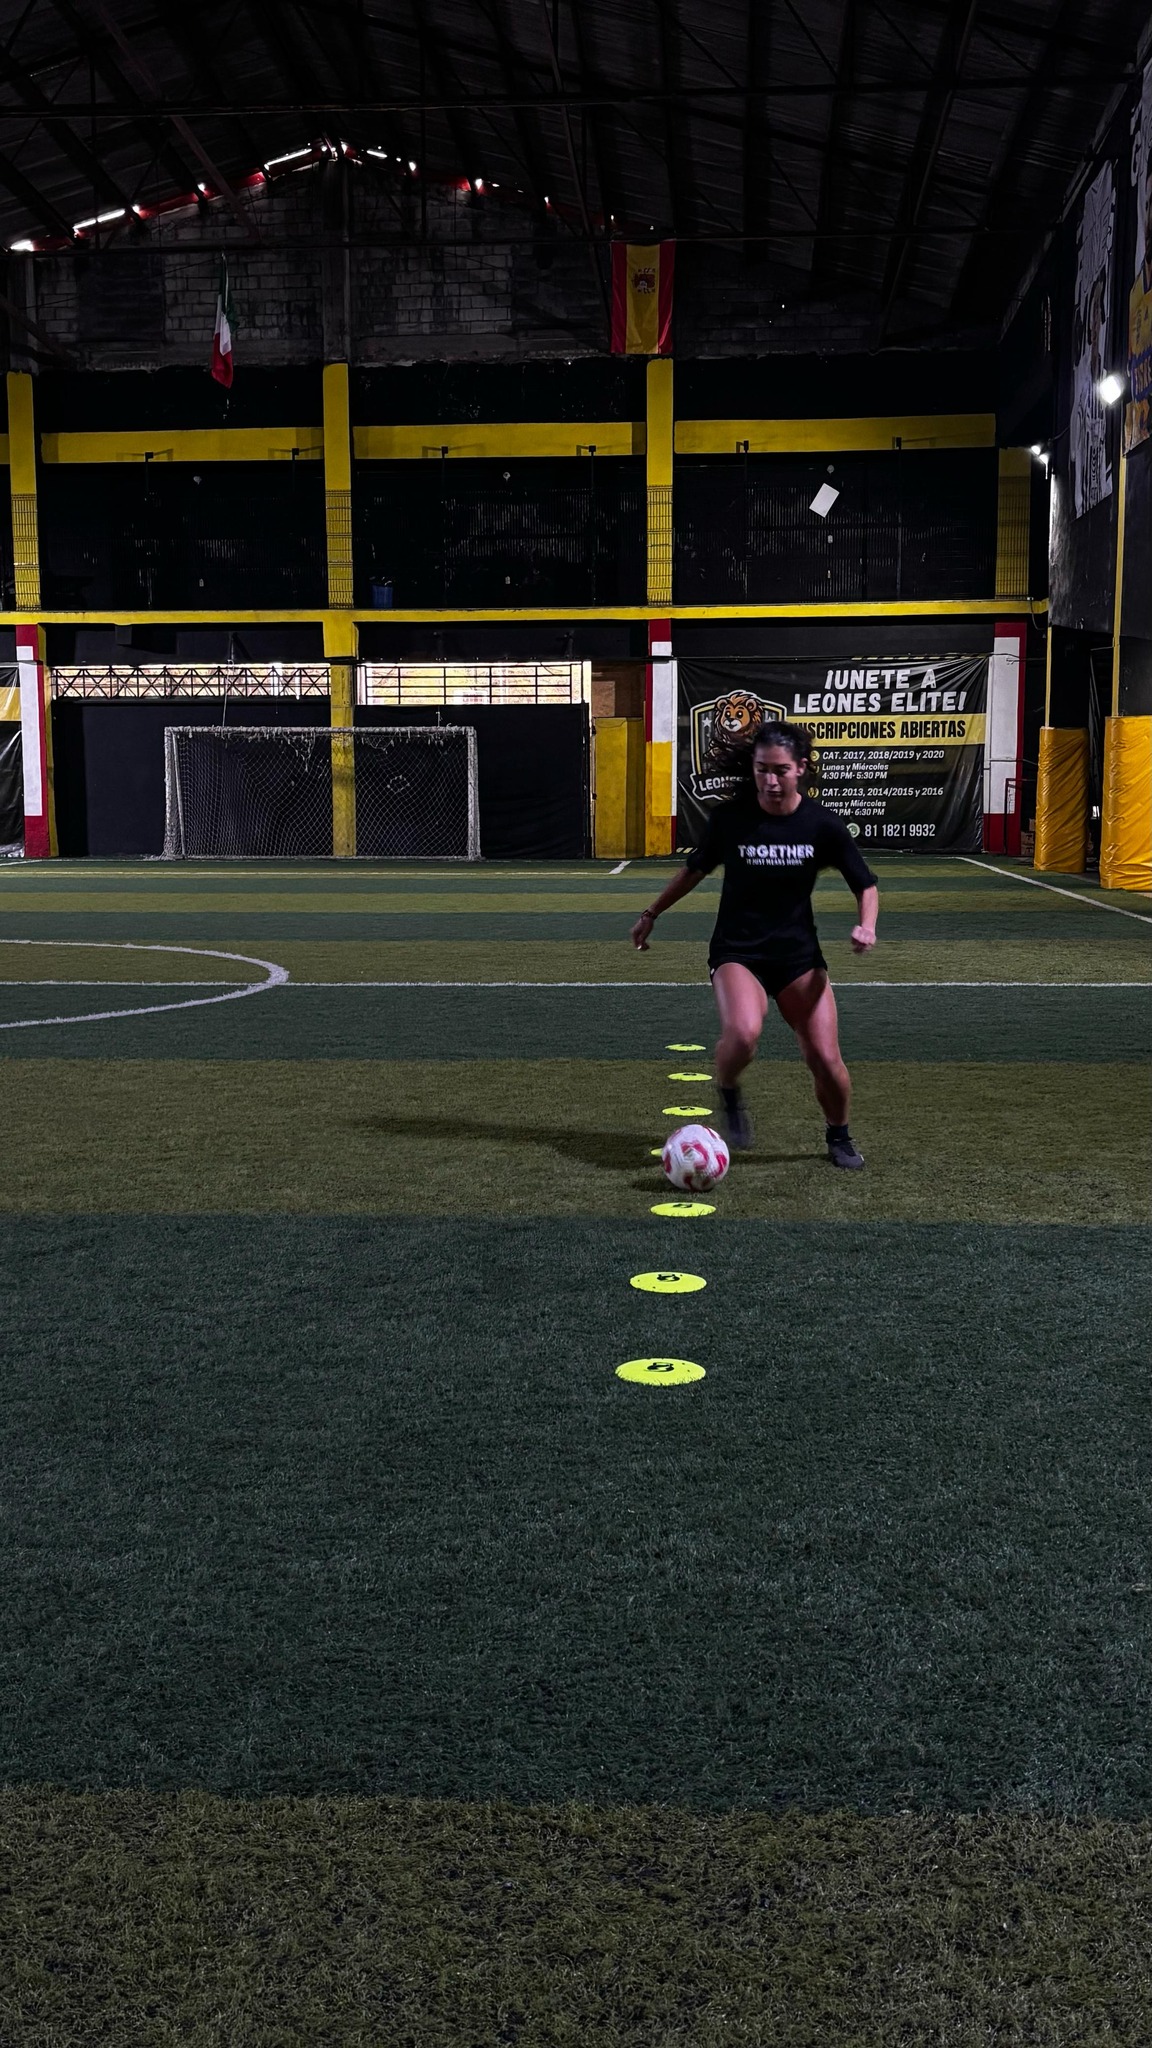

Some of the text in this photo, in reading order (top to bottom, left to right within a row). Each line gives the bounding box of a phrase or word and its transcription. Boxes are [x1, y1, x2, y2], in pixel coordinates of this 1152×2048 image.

[921, 668, 937, 689] A
[793, 691, 968, 713] LEONES ELITE!
[900, 720, 966, 739] ABIERTAS
[822, 750, 945, 761] CAT. 2017, 2018/2019 y 2020
[822, 763, 889, 772] Lunes y Miércoles
[822, 772, 839, 780] 4:30
[856, 771, 873, 779] 5:30
[874, 771, 887, 779] PM
[821, 787, 944, 798] CAT. 2013, 2014/2015 y 2016
[821, 800, 843, 808] Lunes
[850, 799, 887, 808] Miércoles
[854, 808, 871, 816] 6:30
[872, 808, 885, 816] PM
[864, 824, 936, 837] 81 1821 9932
[738, 844, 815, 859] TOGETHER
